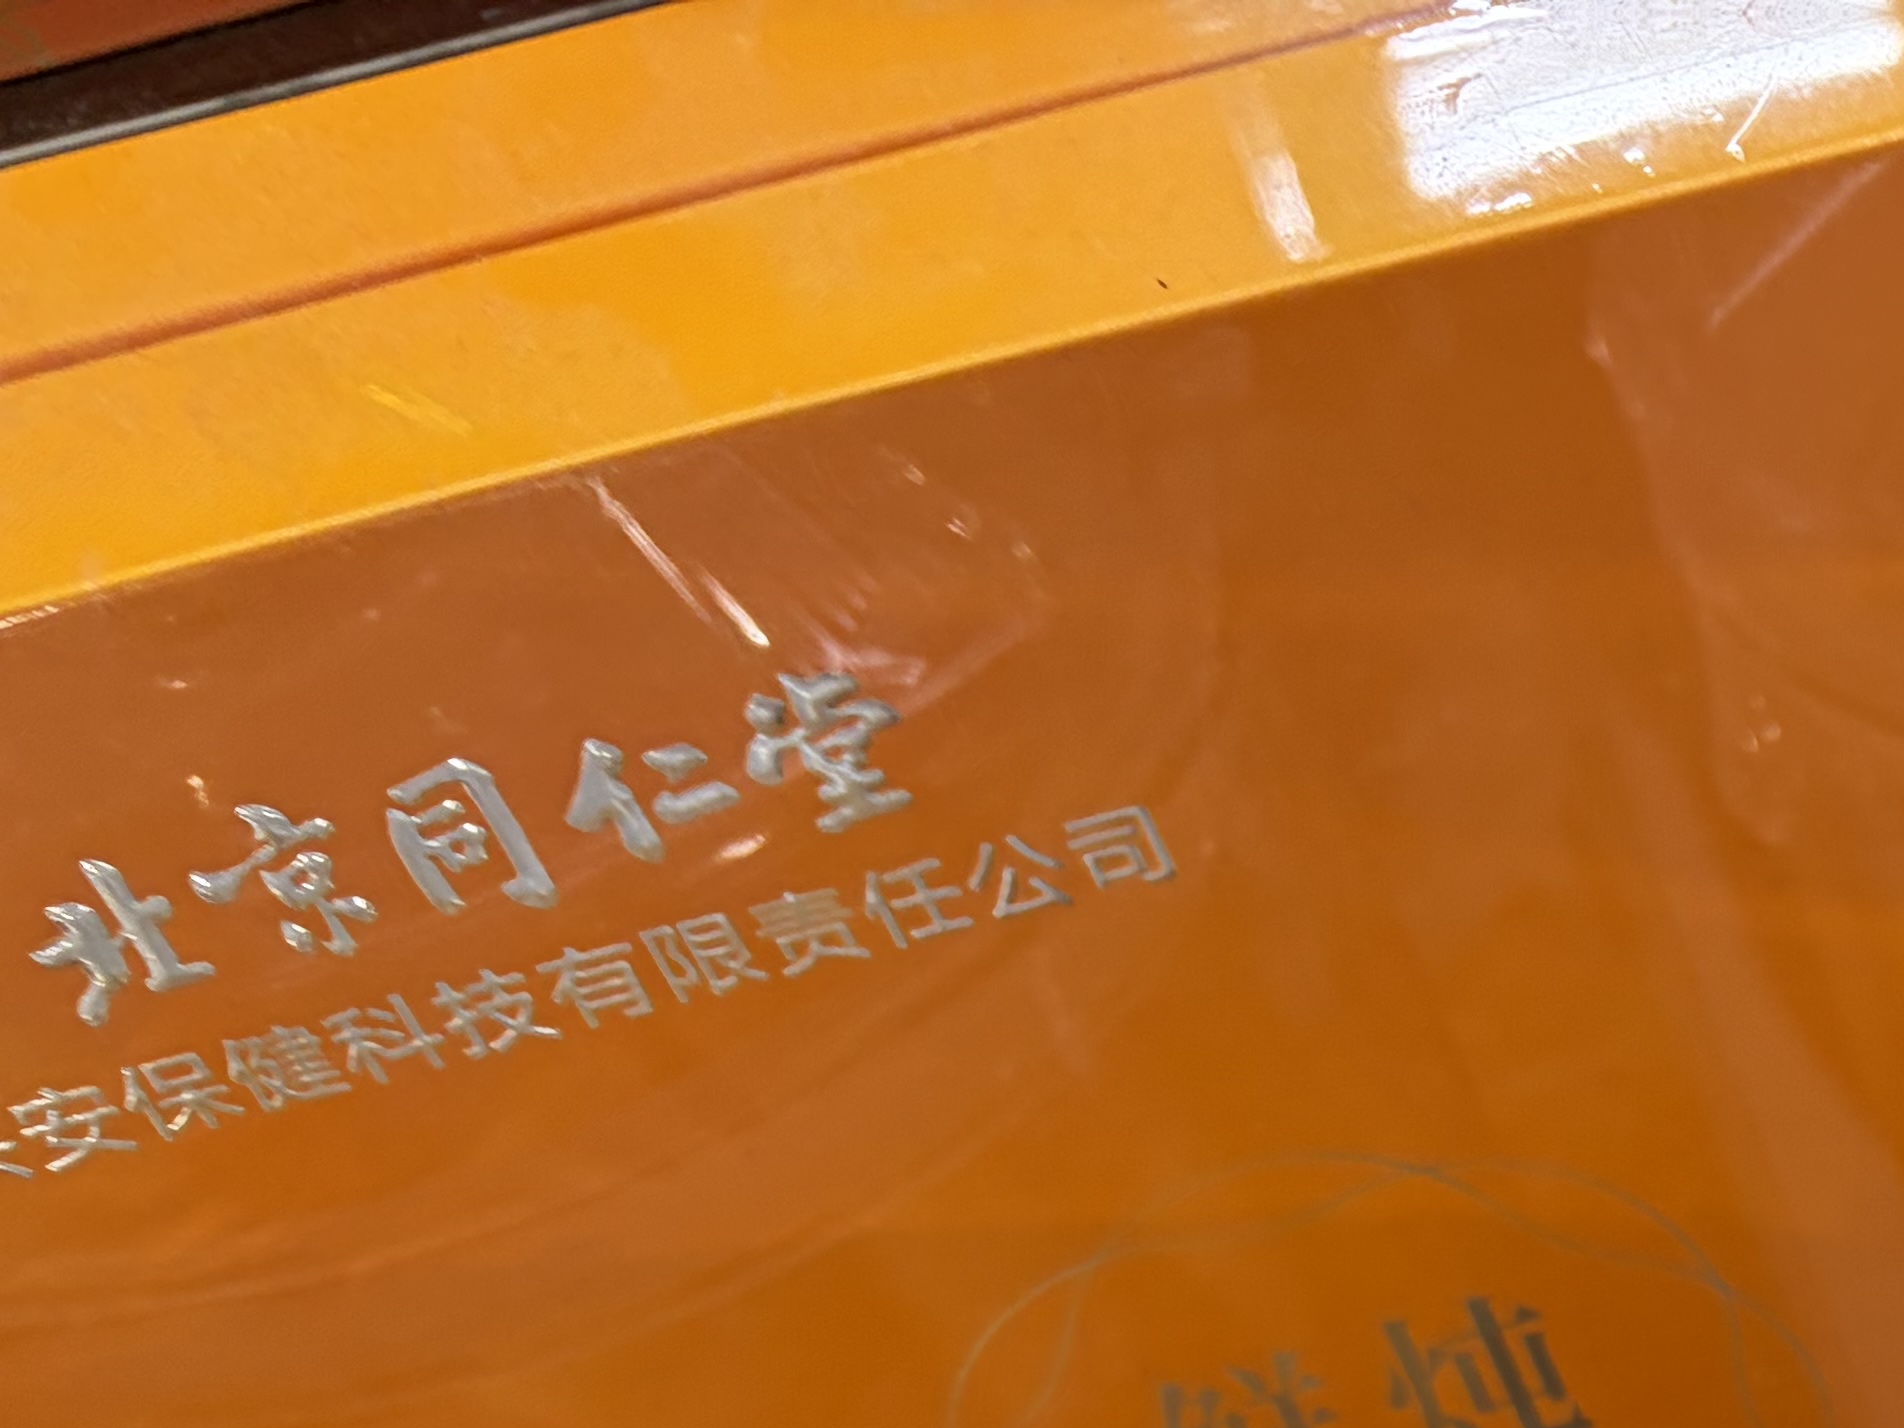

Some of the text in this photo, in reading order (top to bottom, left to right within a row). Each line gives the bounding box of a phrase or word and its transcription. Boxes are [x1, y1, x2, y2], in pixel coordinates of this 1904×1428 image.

[0, 804, 1178, 1178] 安保健科技有限责任公司
[29, 670, 912, 1025] 北京同仁堂
